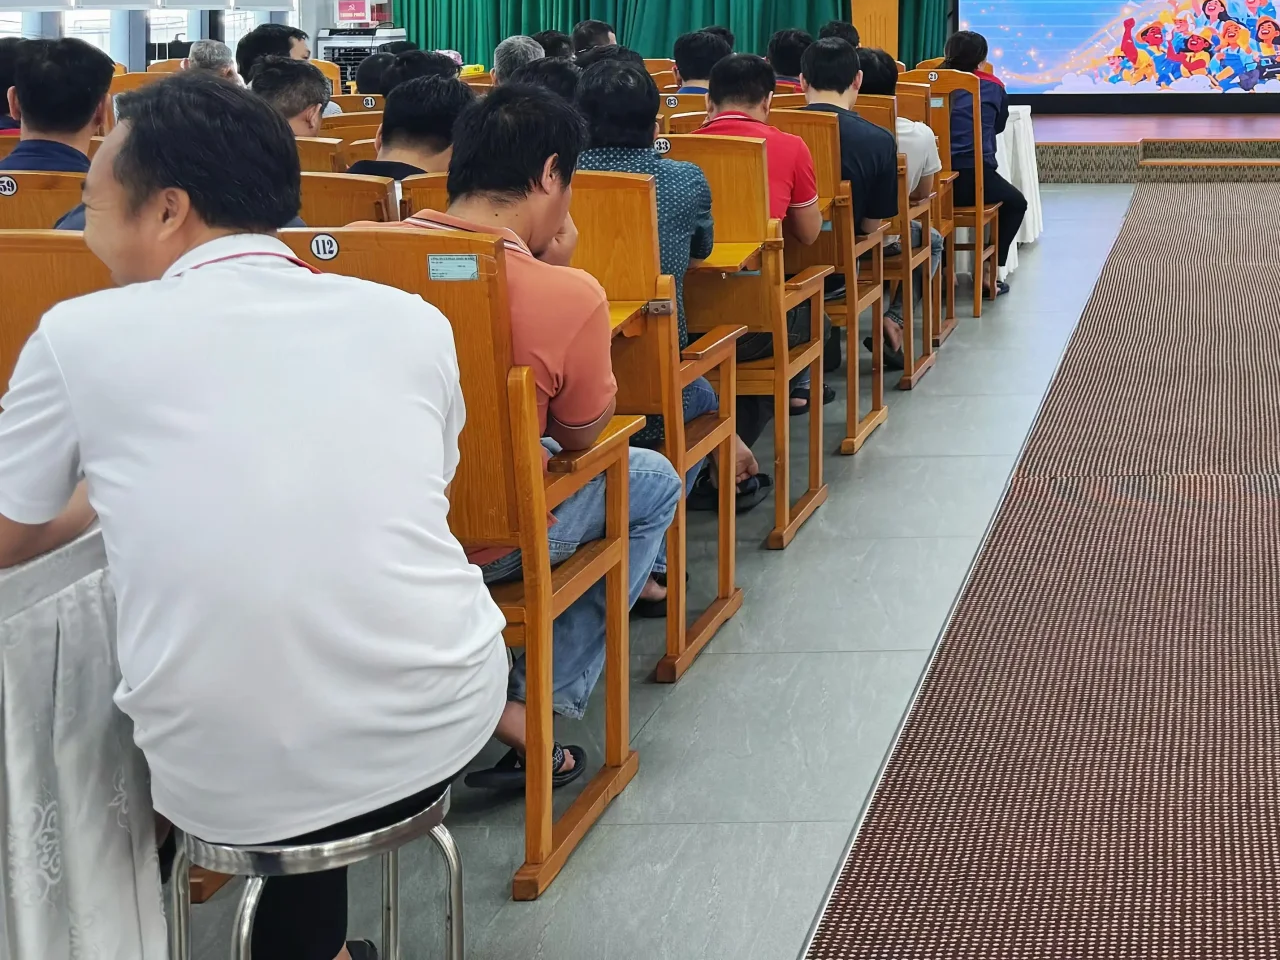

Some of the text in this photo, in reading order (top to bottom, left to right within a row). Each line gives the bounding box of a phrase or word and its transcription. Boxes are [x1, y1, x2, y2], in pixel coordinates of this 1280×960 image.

[656, 141, 668, 150] 33
[0, 180, 15, 192] 59
[315, 239, 335, 255] 112
